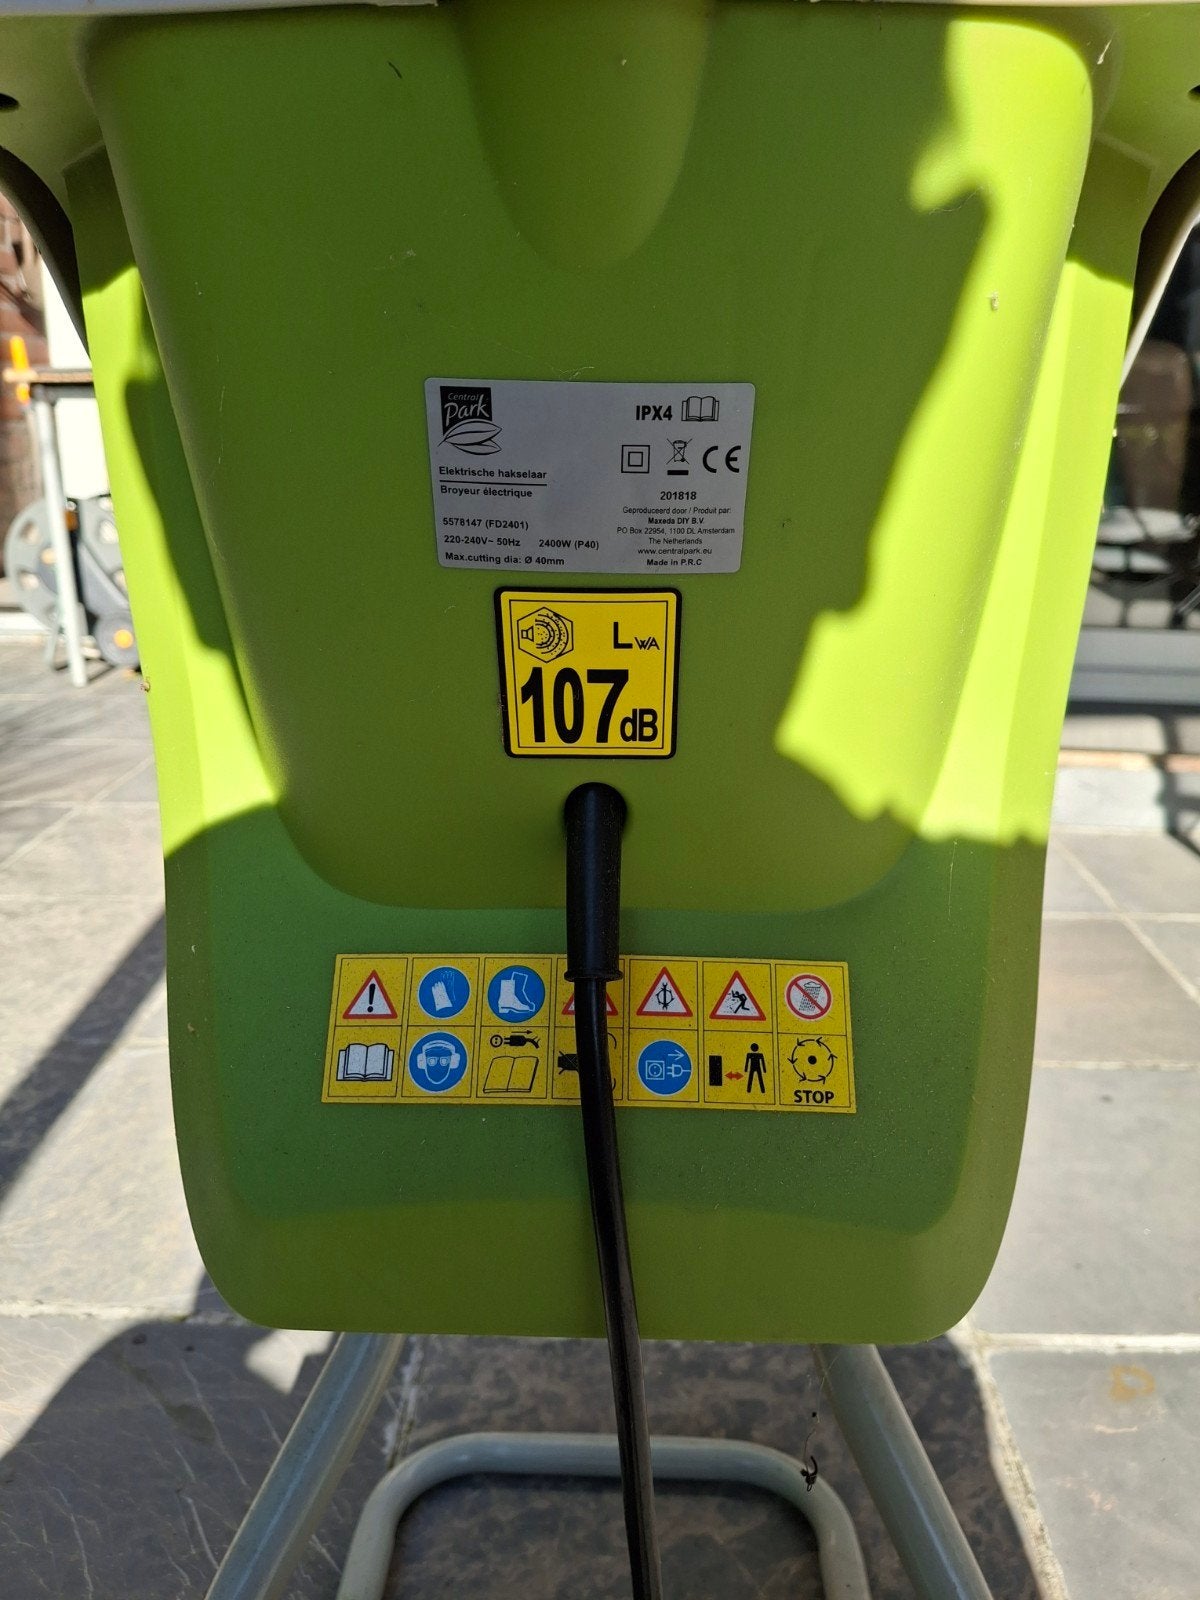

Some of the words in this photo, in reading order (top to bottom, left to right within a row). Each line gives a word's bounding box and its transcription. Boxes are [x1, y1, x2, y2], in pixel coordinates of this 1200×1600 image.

[444, 394, 490, 427] Park
[636, 405, 672, 420] IPX4
[438, 466, 494, 477] Elektrische
[498, 469, 547, 479] hakselaar
[440, 484, 480, 496] Broyeur
[483, 487, 532, 498] électrique
[660, 491, 697, 500] 201818
[622, 506, 670, 514] Geproduceerd
[442, 518, 482, 528] 5578147
[485, 519, 529, 531] (FD2401)
[630, 526, 642, 534] Box
[644, 527, 668, 536] 22954,
[444, 535, 494, 545] 220-240V~
[496, 538, 520, 547] 50Hz
[538, 540, 572, 548] 2400W
[574, 540, 600, 550] (P40)
[638, 546, 712, 556] www.centralpark.eu
[446, 552, 500, 564] Max.cutting
[504, 555, 522, 564] dia:
[524, 556, 532, 564] Ø
[535, 556, 565, 565] 40mm
[794, 1090, 834, 1104] STOP
